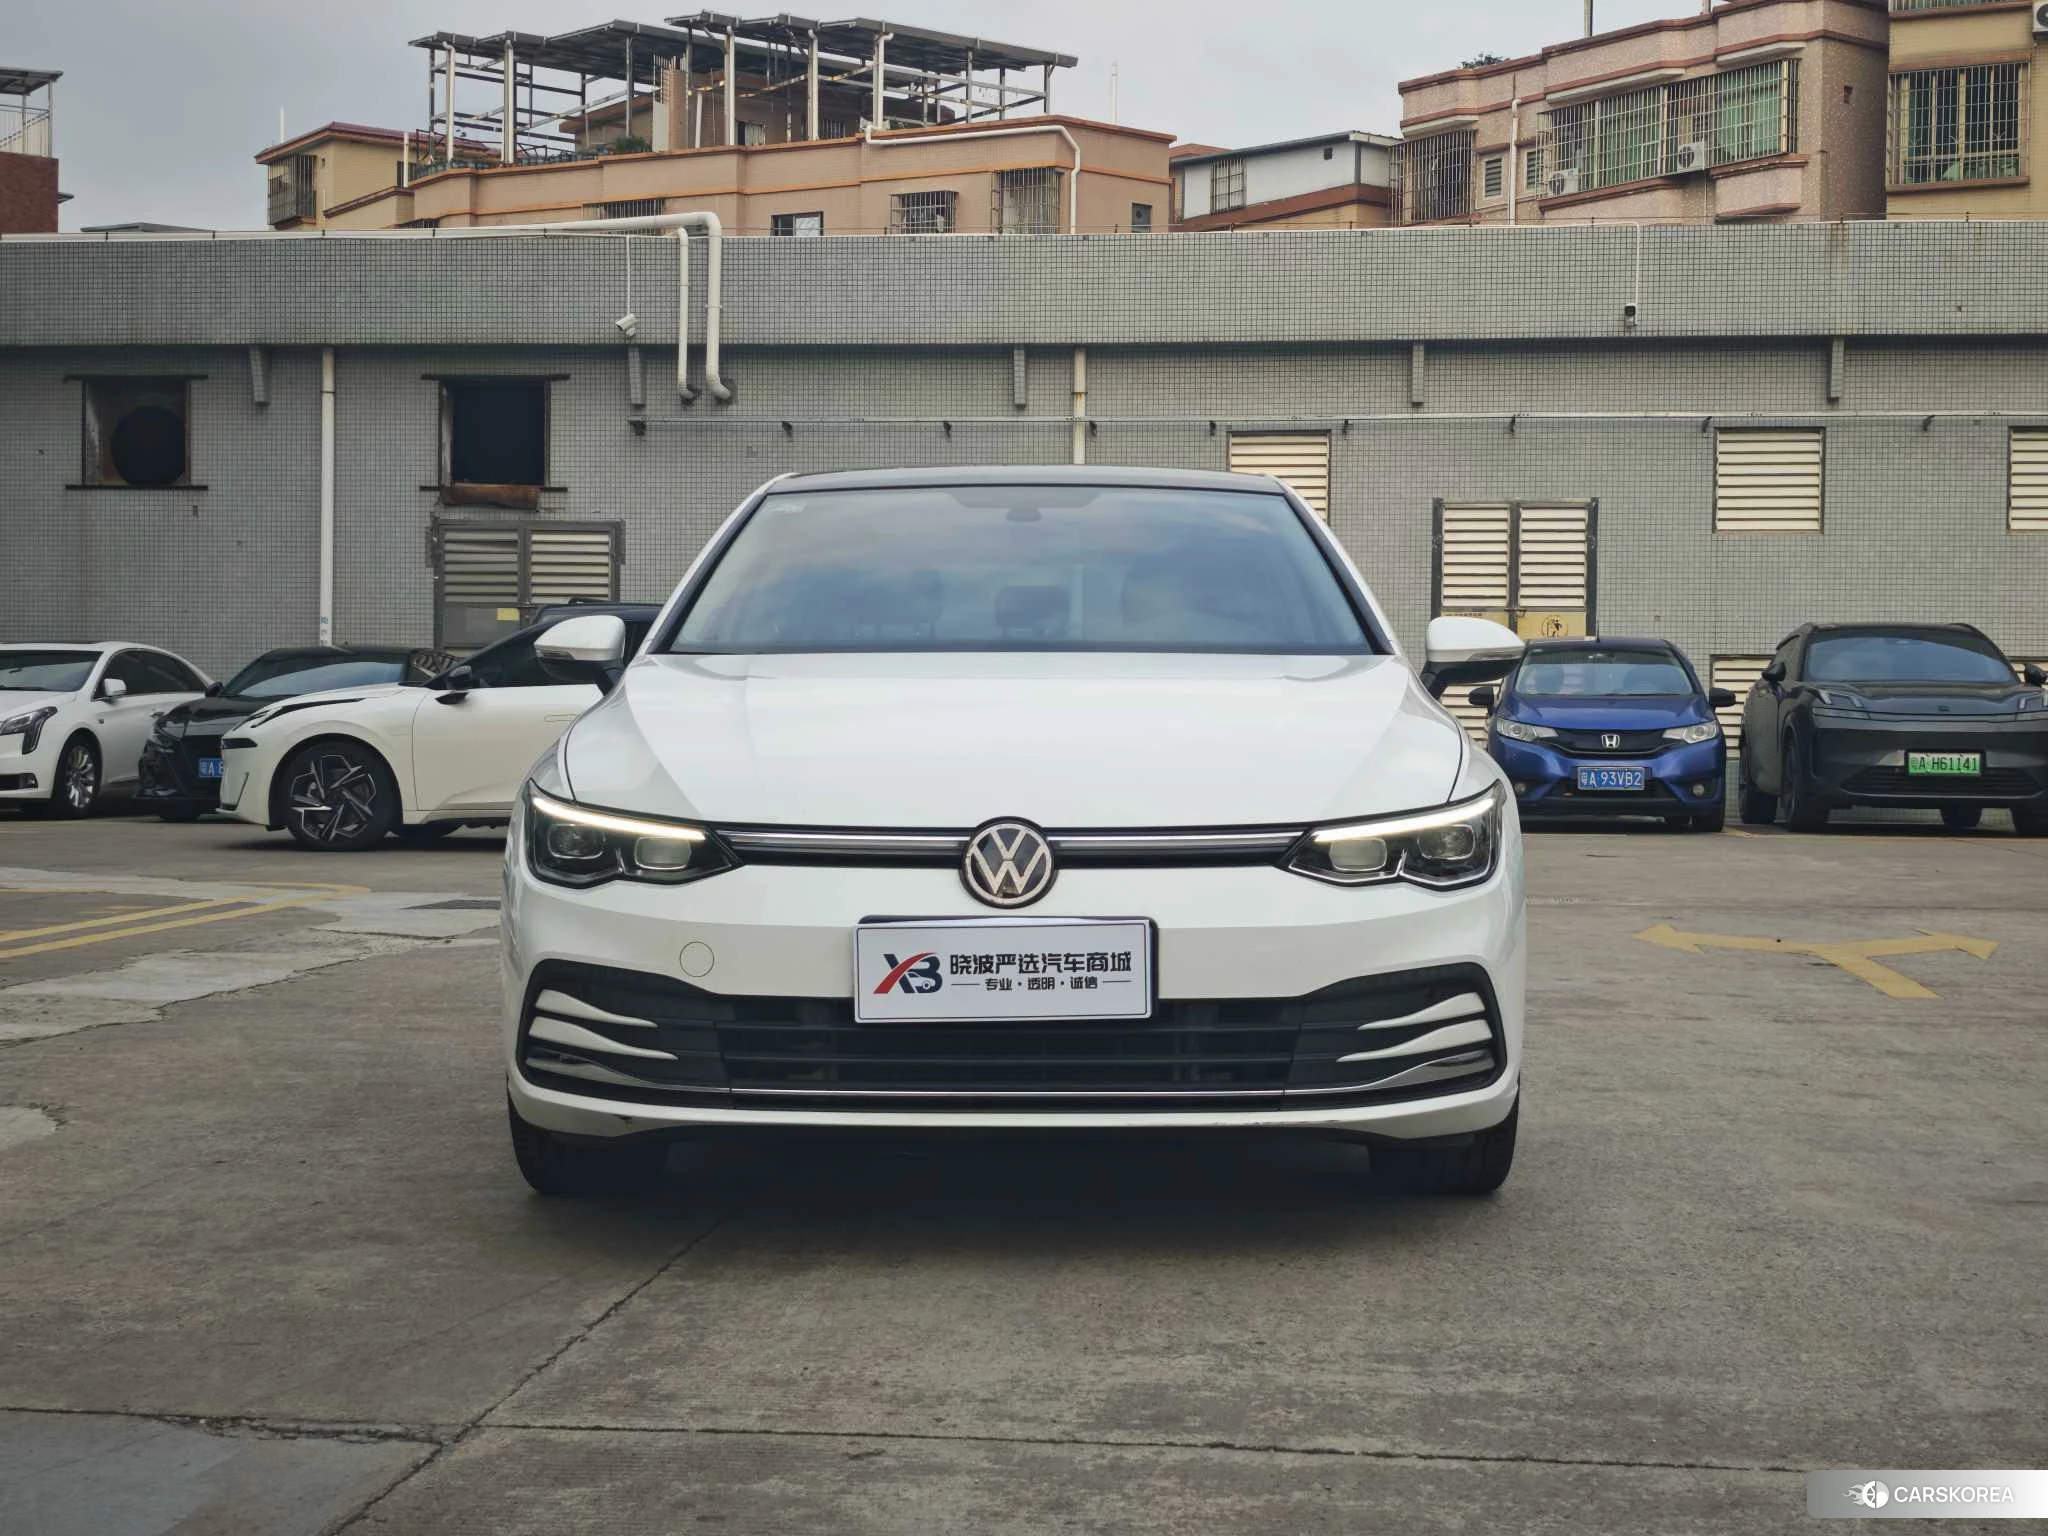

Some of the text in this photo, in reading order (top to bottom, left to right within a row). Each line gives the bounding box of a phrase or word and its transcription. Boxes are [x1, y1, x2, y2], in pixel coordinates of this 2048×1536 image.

[950, 951, 1132, 975] 晓波严选汽车商城
